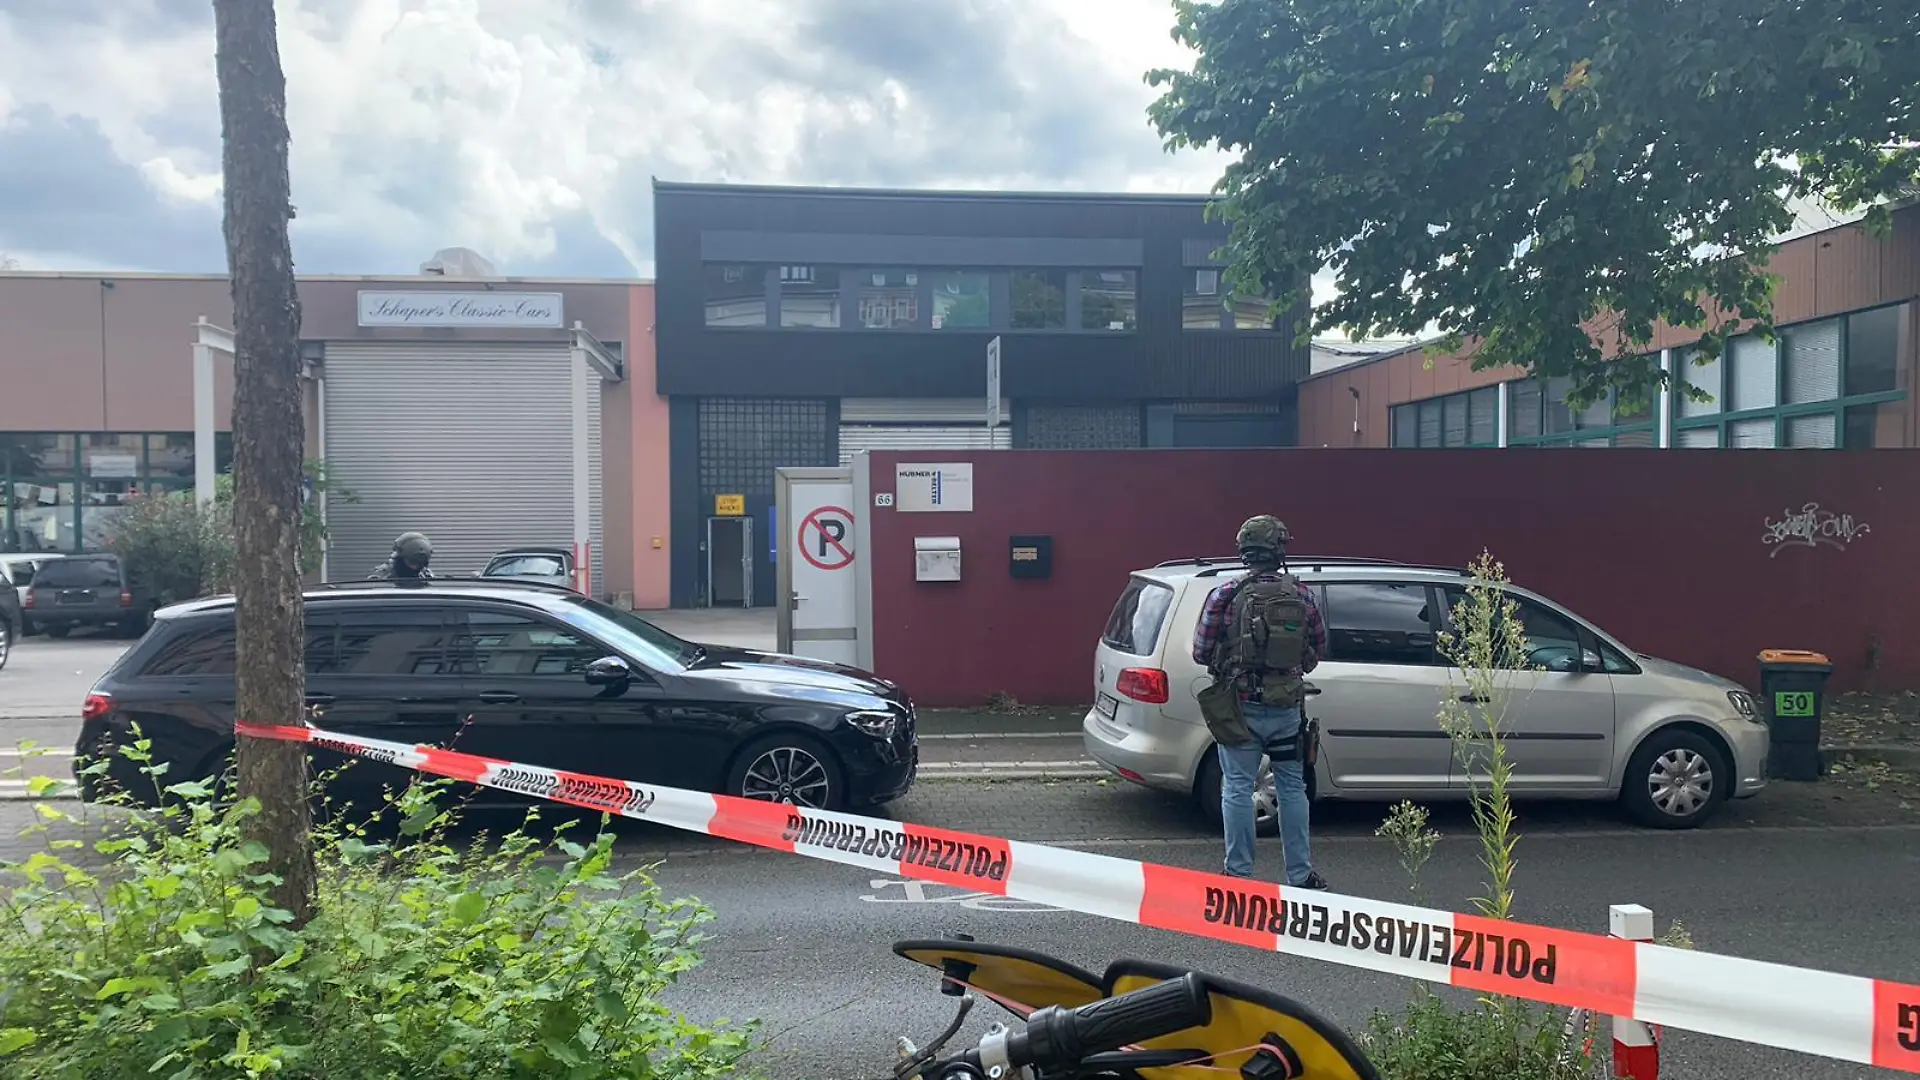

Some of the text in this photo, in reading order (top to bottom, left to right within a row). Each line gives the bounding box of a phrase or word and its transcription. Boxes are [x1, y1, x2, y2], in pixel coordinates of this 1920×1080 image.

[877, 495, 890, 505] 66
[1783, 694, 1808, 710] 50
[781, 813, 1008, 881] POLIZEIABSPERRUNG
[1204, 886, 1556, 985] POLIZEIABSPERRUNG
